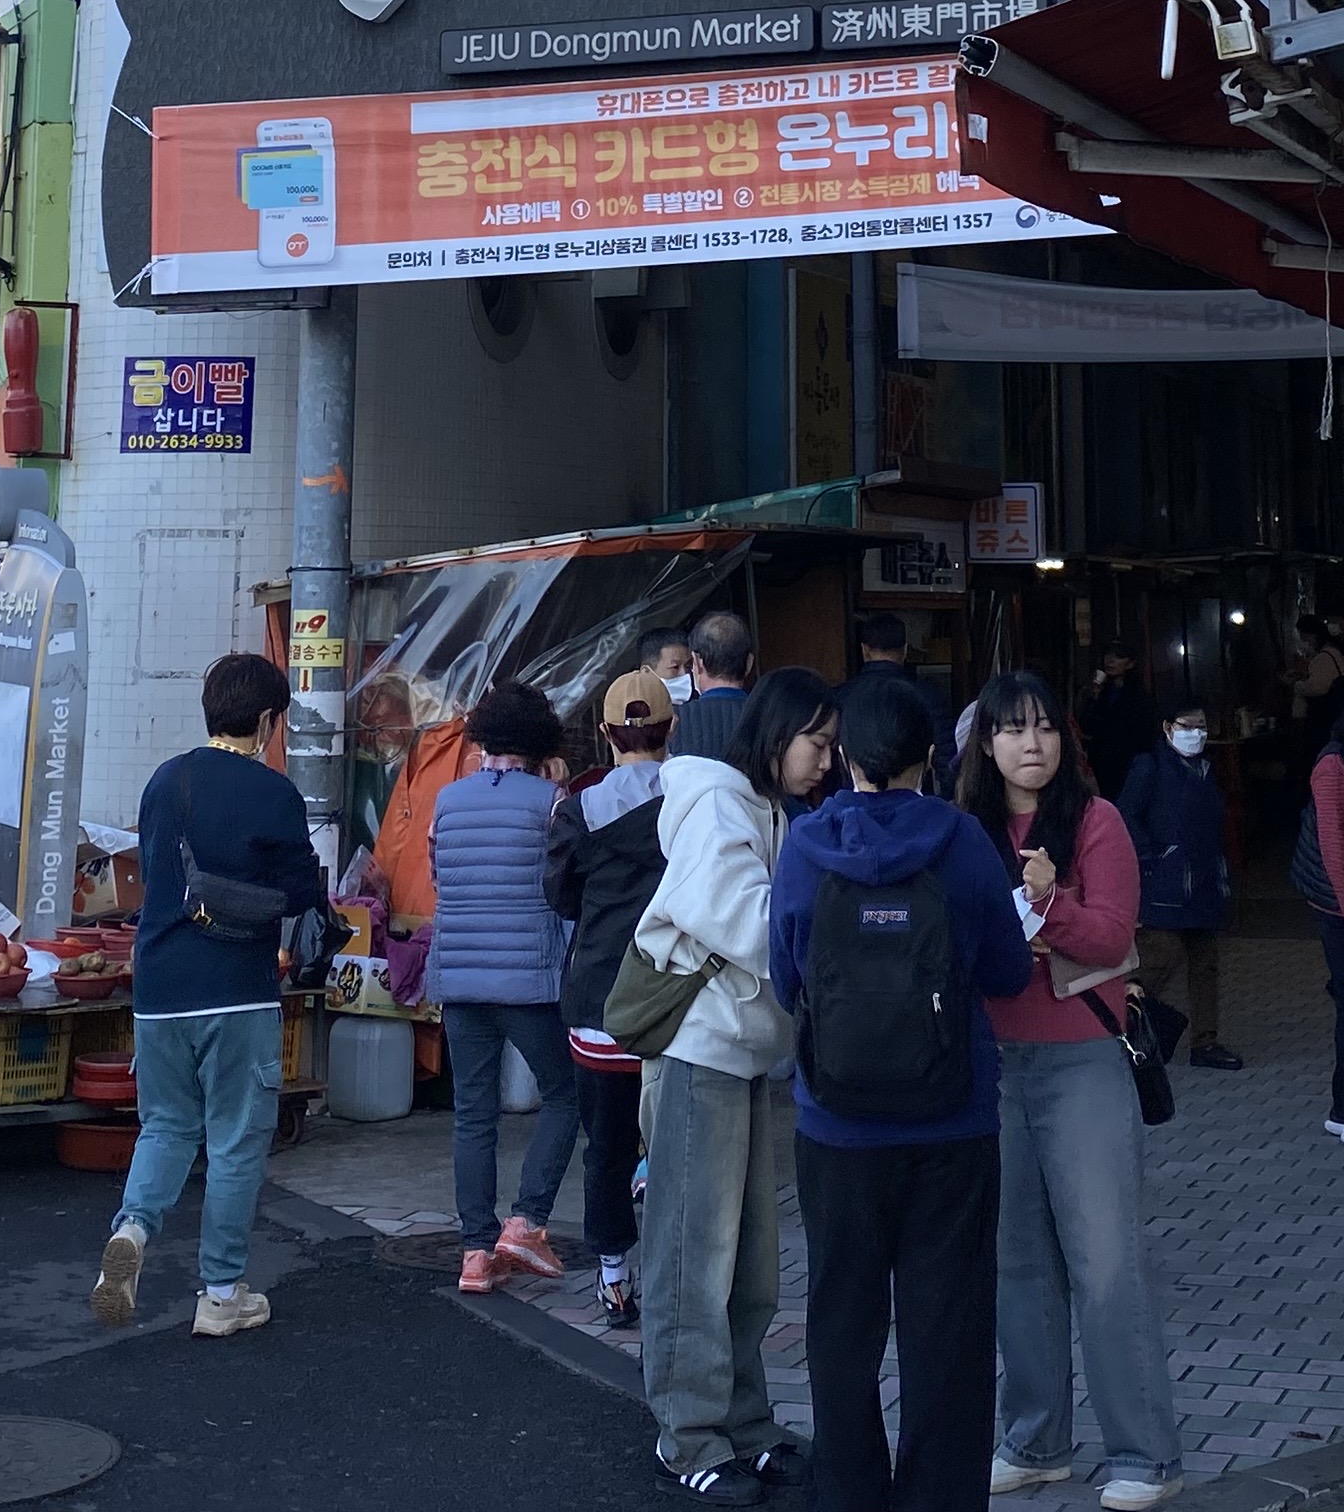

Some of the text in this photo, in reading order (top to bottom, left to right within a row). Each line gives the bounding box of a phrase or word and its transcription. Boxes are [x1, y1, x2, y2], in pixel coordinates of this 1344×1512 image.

[453, 12, 803, 65] JEJU Dongmun Market
[596, 87, 711, 117] 휴대폰으로
[717, 76, 810, 107] 충전하고
[817, 76, 840, 98] 내
[847, 69, 919, 96] 카드로
[416, 100, 960, 199] 충전식 카드형 온누리
[482, 199, 562, 226] 사용혜택
[596, 195, 637, 218] 10%
[643, 188, 724, 214] 특별할인
[759, 180, 841, 207] 전통시장
[847, 174, 931, 201] 소득공제
[387, 250, 433, 269] 문의처
[455, 246, 501, 266] 충전식
[504, 243, 550, 263] 카드형
[554, 237, 648, 259] 온누리상품권
[651, 233, 698, 254] 콜센터
[801, 214, 949, 242] 중소기업통합콜센터
[953, 212, 994, 231] 1357
[129, 359, 250, 407] 금이빨
[127, 434, 244, 450] 010-2634-9933
[153, 408, 225, 433] 삽니다
[975, 499, 1029, 525] 바른
[975, 529, 1030, 554] 쥬스
[294, 614, 327, 634] 119
[289, 643, 343, 661] 결송수구
[35, 695, 71, 915] Dong Mun Market
